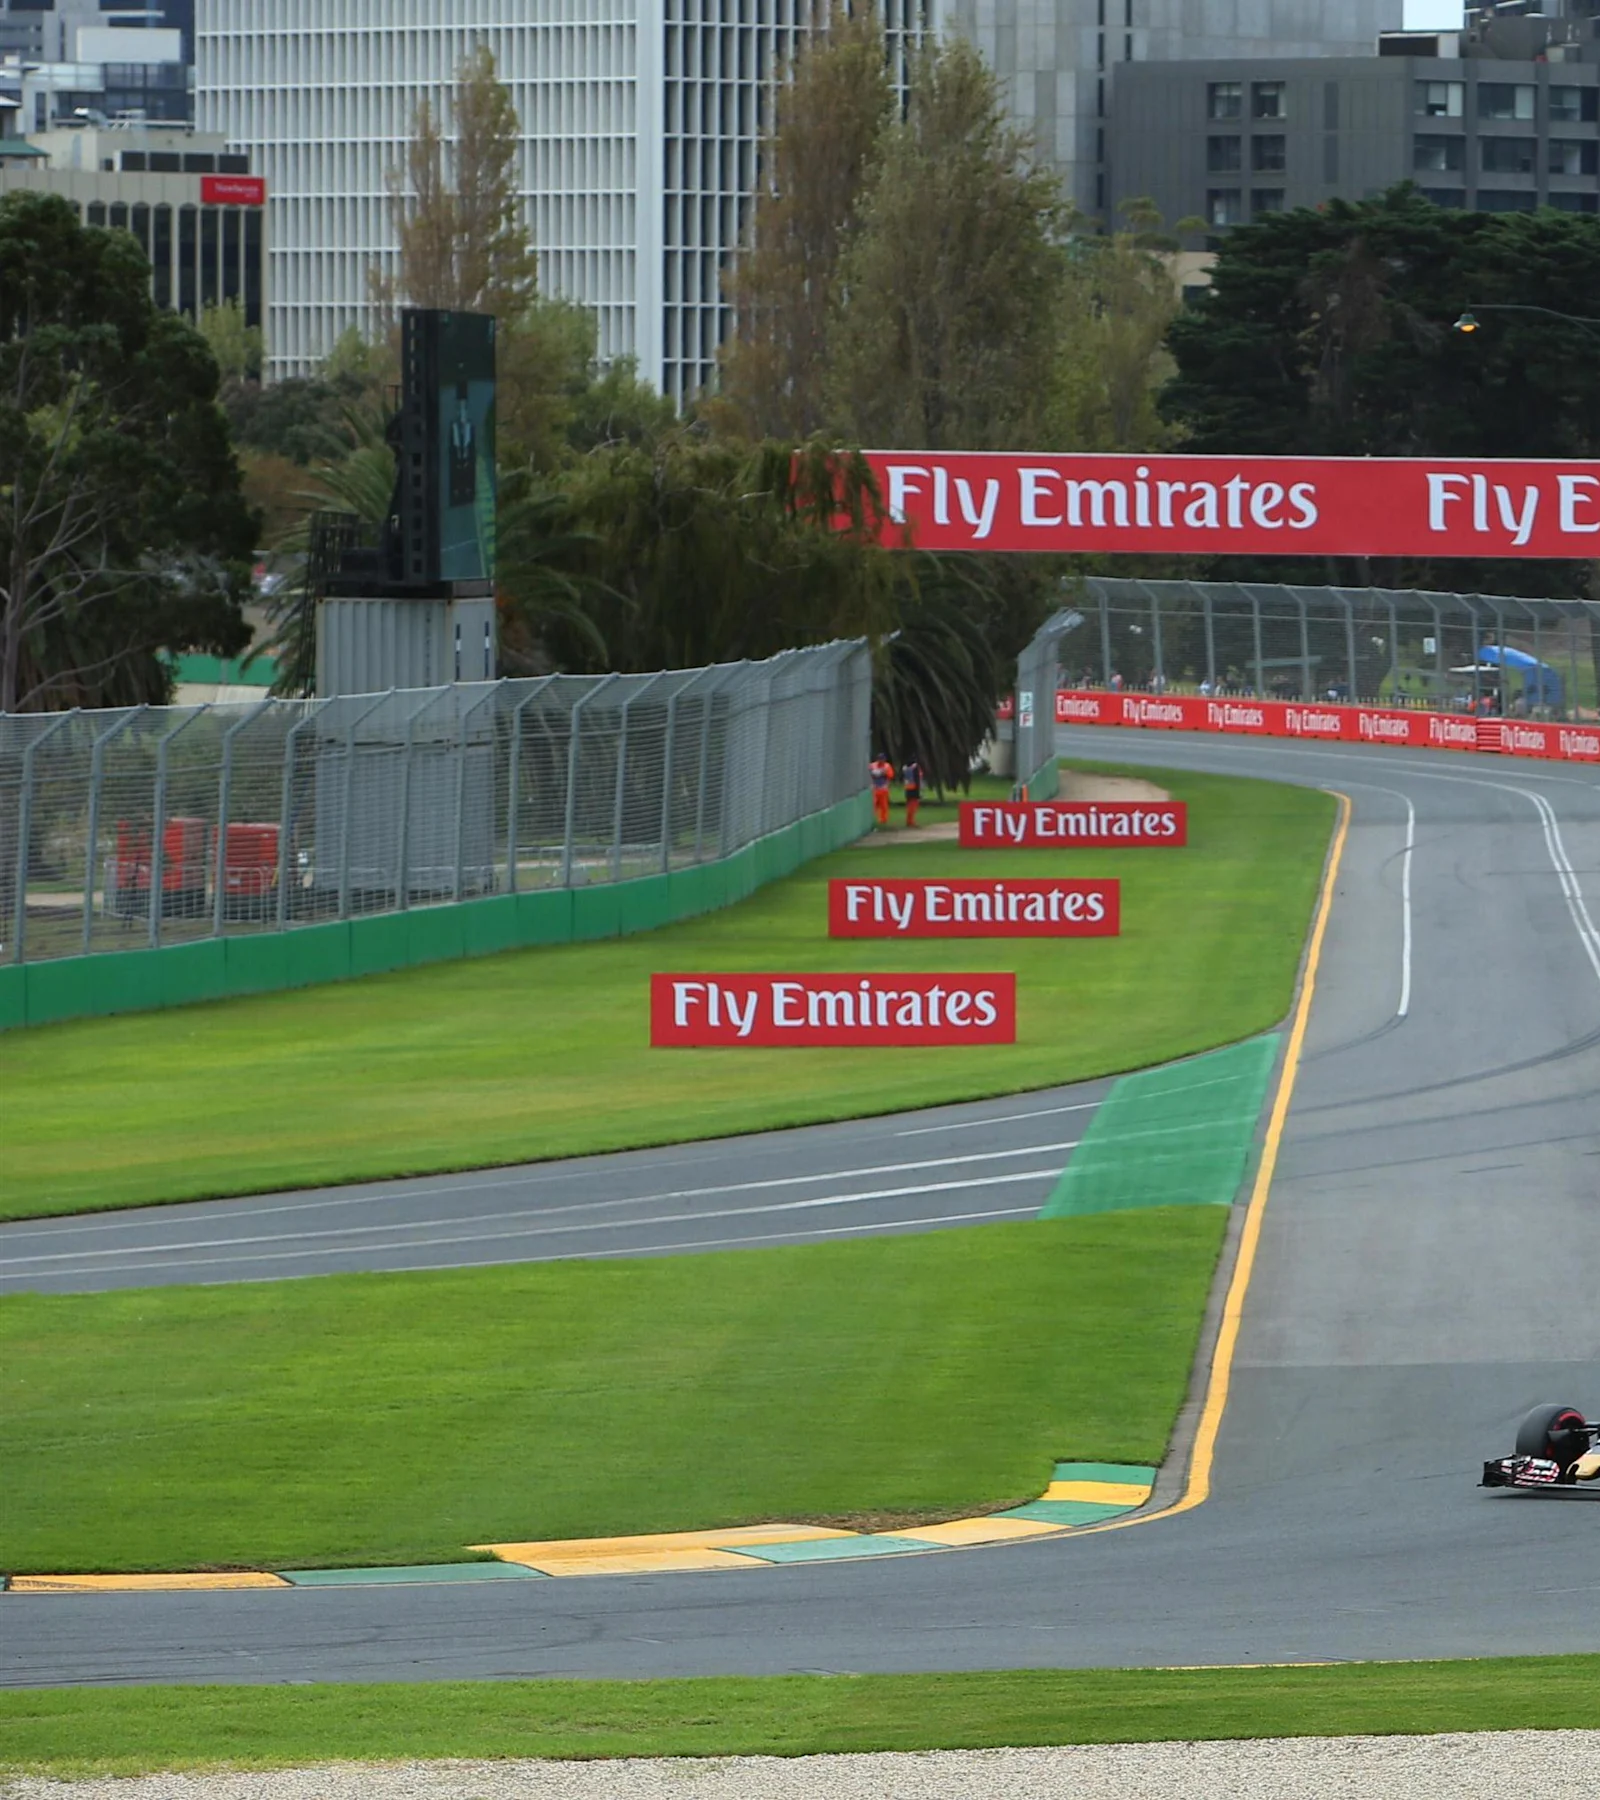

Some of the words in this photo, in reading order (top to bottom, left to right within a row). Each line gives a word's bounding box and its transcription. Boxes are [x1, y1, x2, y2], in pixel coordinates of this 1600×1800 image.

[886, 465, 1000, 539] Fly
[1017, 466, 1318, 529] Emirates
[1426, 473, 1539, 546] Fly
[1056, 695, 1100, 717] Emirates
[1123, 698, 1140, 724] Fly
[1140, 699, 1183, 722] Emirates
[1208, 703, 1224, 728] Fly
[1224, 704, 1263, 726] Emirates
[1286, 708, 1301, 734] Fly
[1302, 708, 1340, 732] Emirates
[1359, 713, 1374, 739] Fly
[1374, 714, 1409, 737] Emirates
[974, 807, 1026, 842] Fly
[1034, 807, 1176, 836] Emirates
[845, 885, 914, 929] Fly
[924, 884, 1104, 922] Emirates
[672, 982, 758, 1036] Fly
[771, 980, 997, 1027] Emirates
